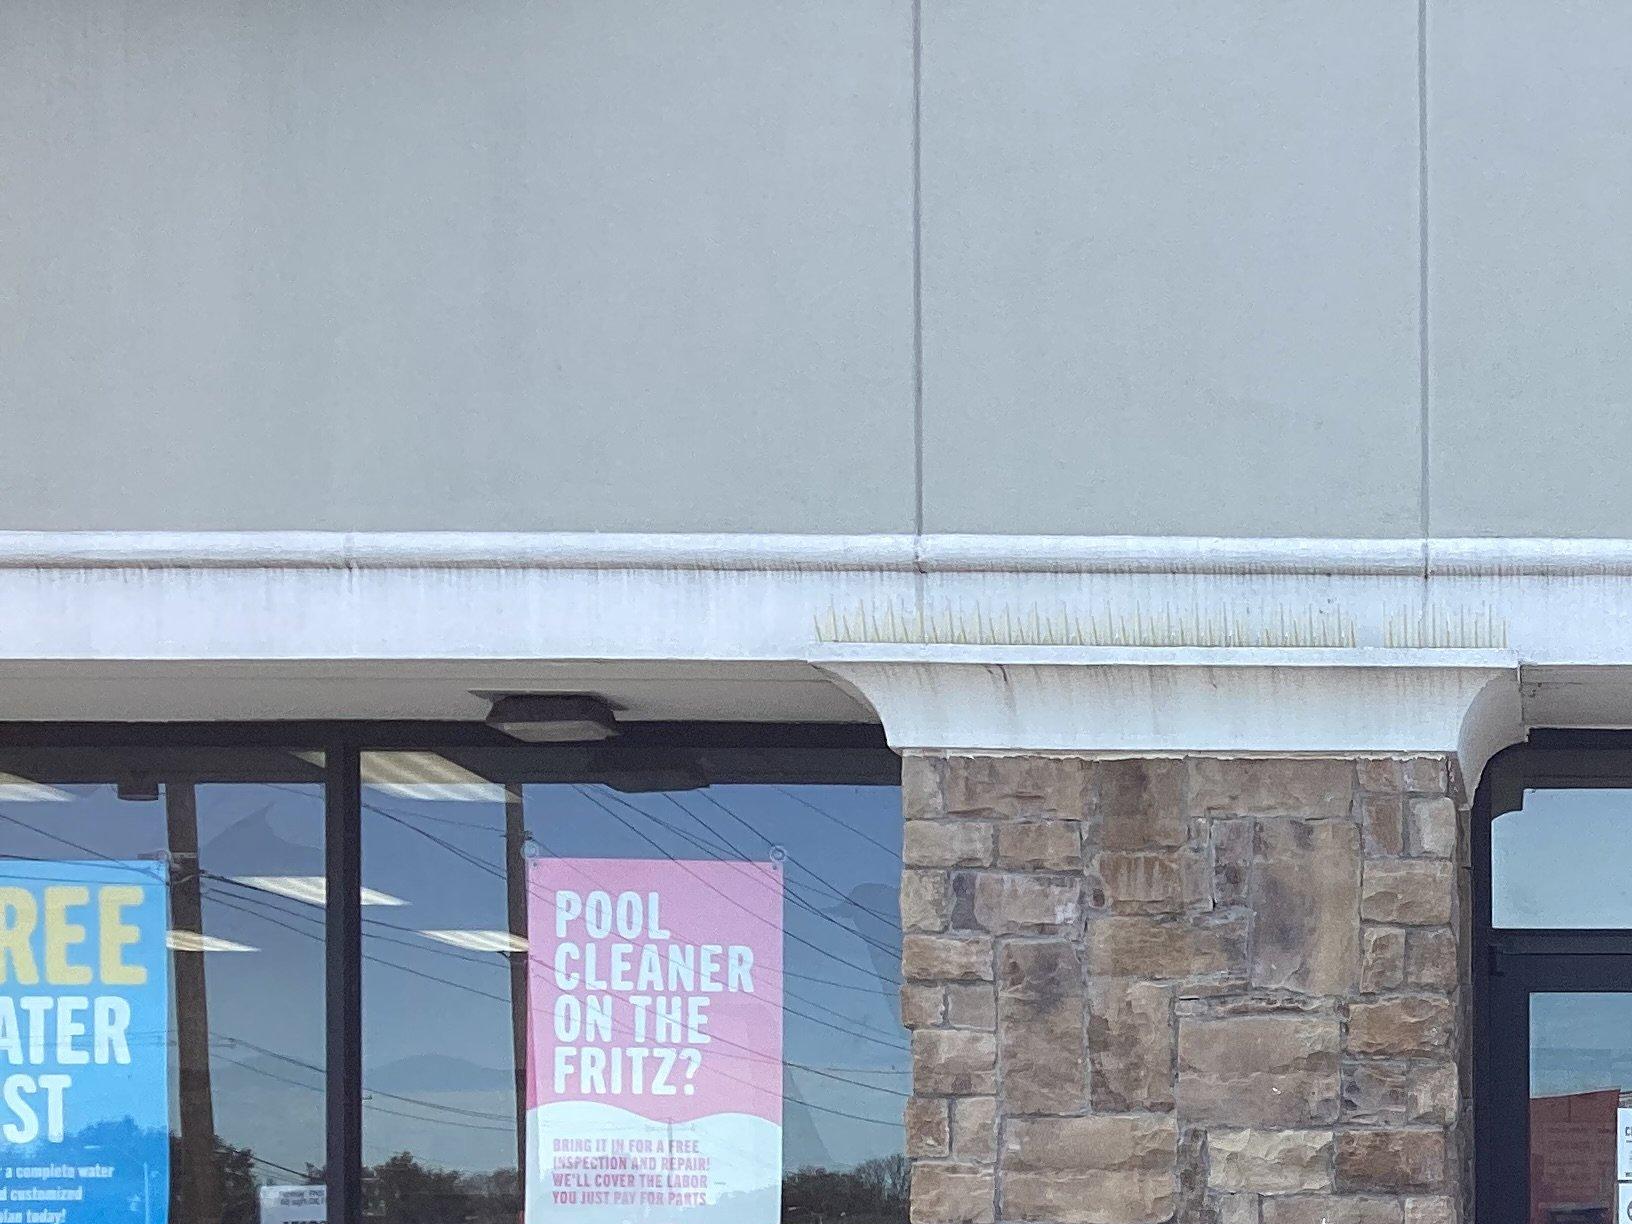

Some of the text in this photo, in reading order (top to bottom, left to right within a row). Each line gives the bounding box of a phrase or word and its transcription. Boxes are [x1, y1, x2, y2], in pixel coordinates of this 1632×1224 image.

[555, 889, 671, 940] POOL
[554, 942, 754, 993] CLEANER
[554, 995, 711, 1044] ON THE
[554, 1046, 702, 1096] FRITZ?
[553, 1138, 700, 1154] BRING IT IN FOR A FREE
[16, 1164, 75, 1179] complete
[77, 1163, 115, 1178] water
[553, 1156, 711, 1171] INSPECTION AND REPAIR!
[552, 1173, 708, 1189] WE'LL COVER THE LABOR
[11, 1186, 83, 1200] customized
[552, 1191, 577, 1205] YOU
[580, 1191, 610, 1206] JUST
[613, 1191, 636, 1206] PAY
[640, 1191, 664, 1206] FOR
